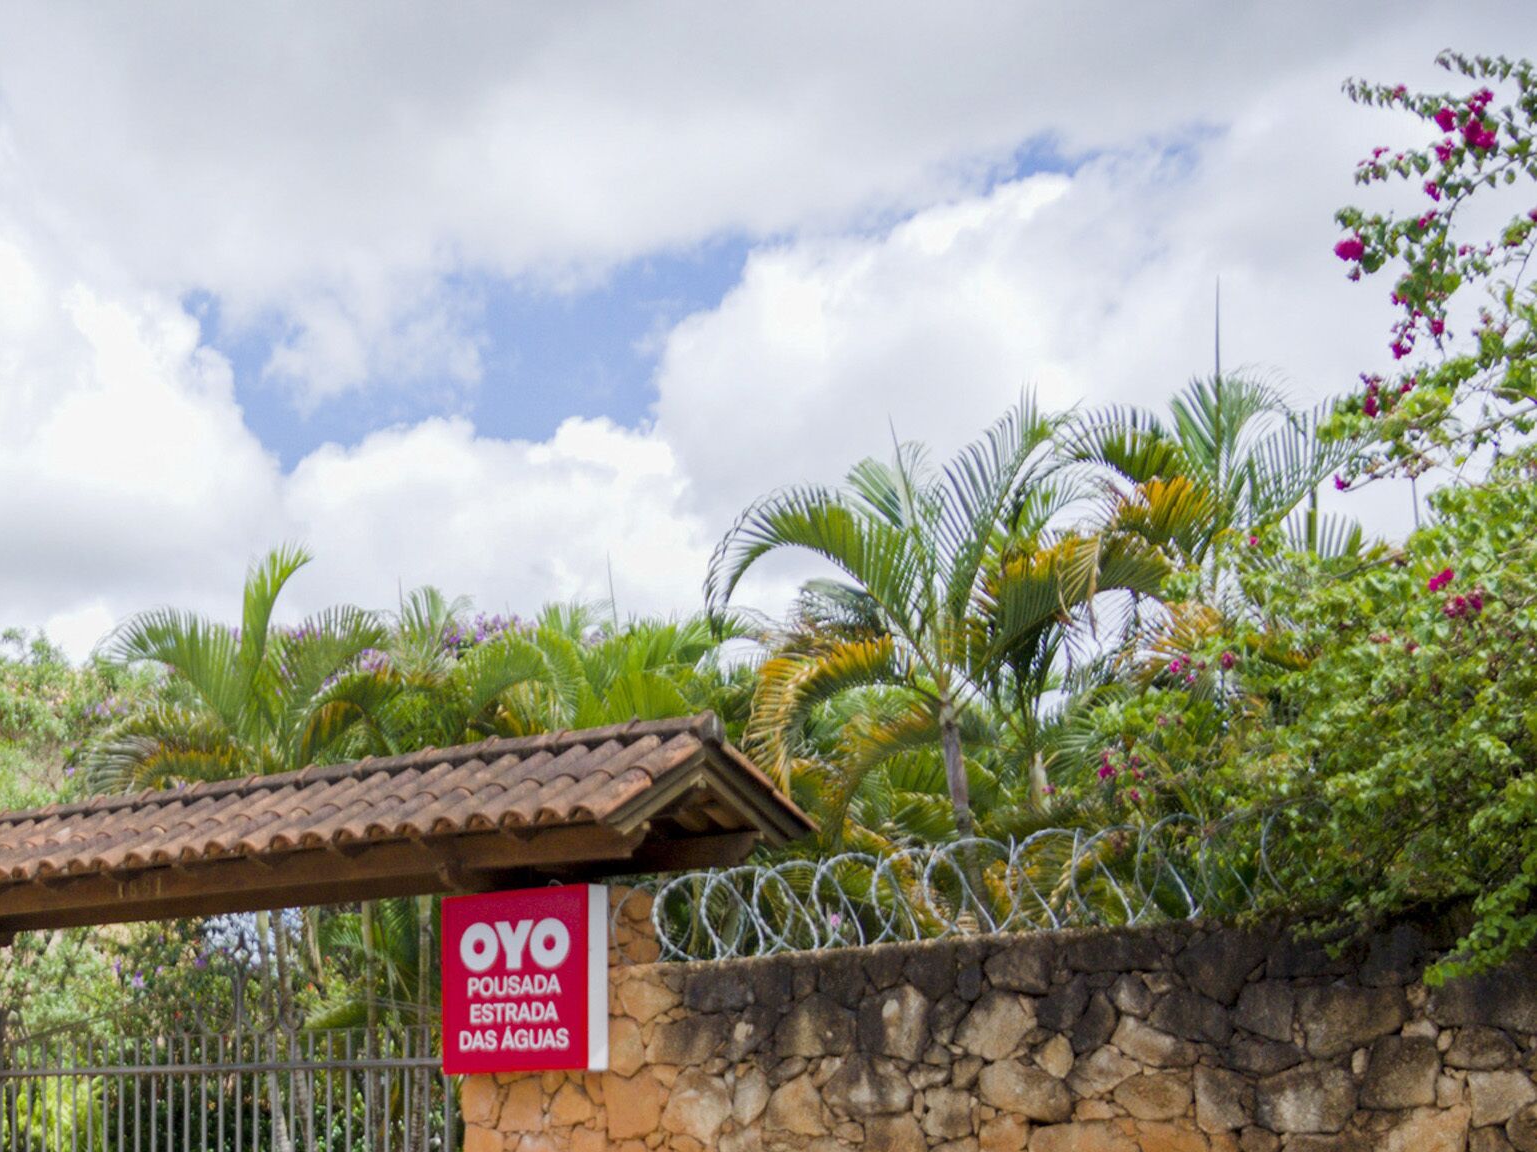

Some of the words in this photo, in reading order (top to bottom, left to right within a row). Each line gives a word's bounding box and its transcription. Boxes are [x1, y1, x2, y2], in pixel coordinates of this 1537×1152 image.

[459, 917, 571, 972] OYO
[466, 973, 562, 998] POUSADA
[469, 1001, 558, 1024] ESTRADA
[459, 1030, 498, 1051] DAS
[501, 1026, 570, 1050] ÁGUAS
